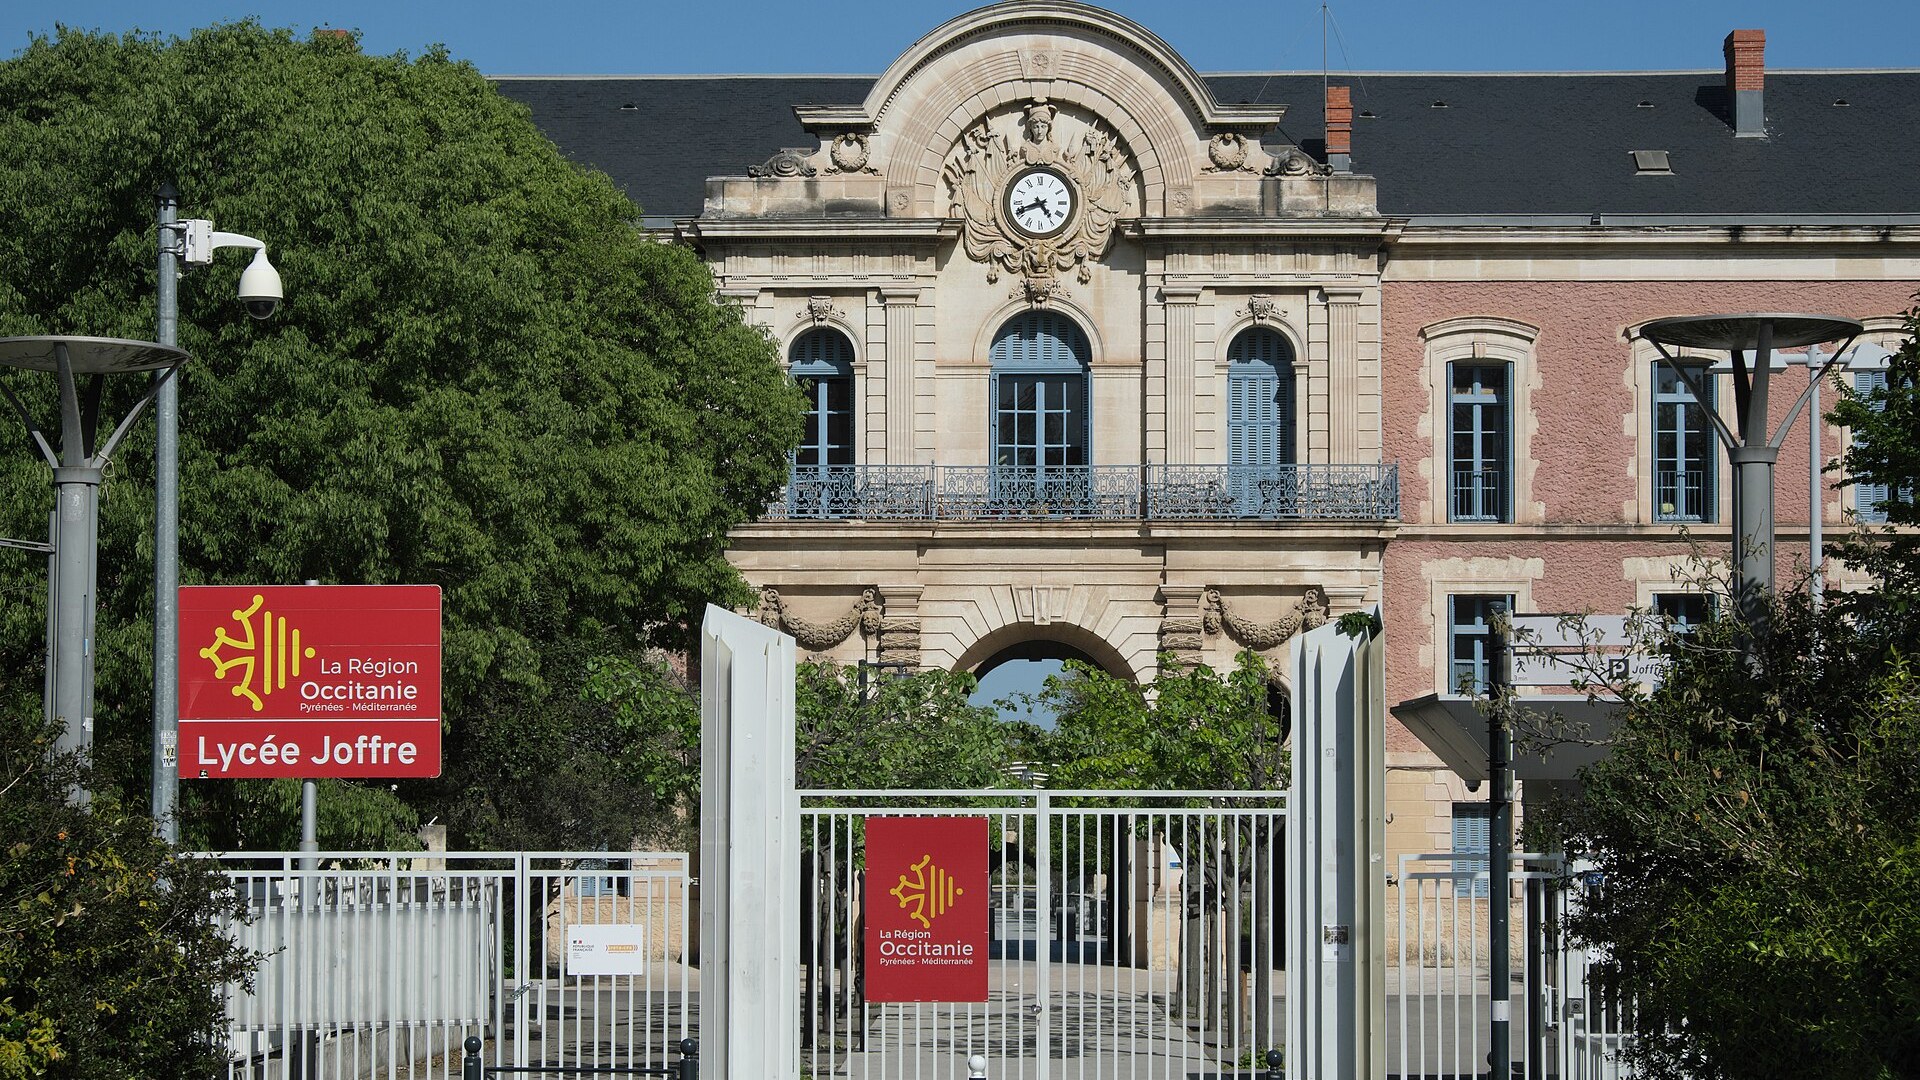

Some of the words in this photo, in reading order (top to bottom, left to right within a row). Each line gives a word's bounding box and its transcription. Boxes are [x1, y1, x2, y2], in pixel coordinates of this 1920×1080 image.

[321, 658, 341, 675] La
[348, 657, 418, 678] Région
[300, 681, 418, 700] Occitanie
[300, 702, 344, 712] Pyrénées
[352, 702, 417, 711] Méditerranée
[198, 734, 300, 772] Lycée
[310, 734, 417, 765] Joffre
[880, 930, 892, 939] La
[894, 929, 931, 941] Région
[880, 940, 973, 956] Occitanie
[880, 957, 915, 966] Pyrénées
[921, 957, 973, 965] Méditerranée
